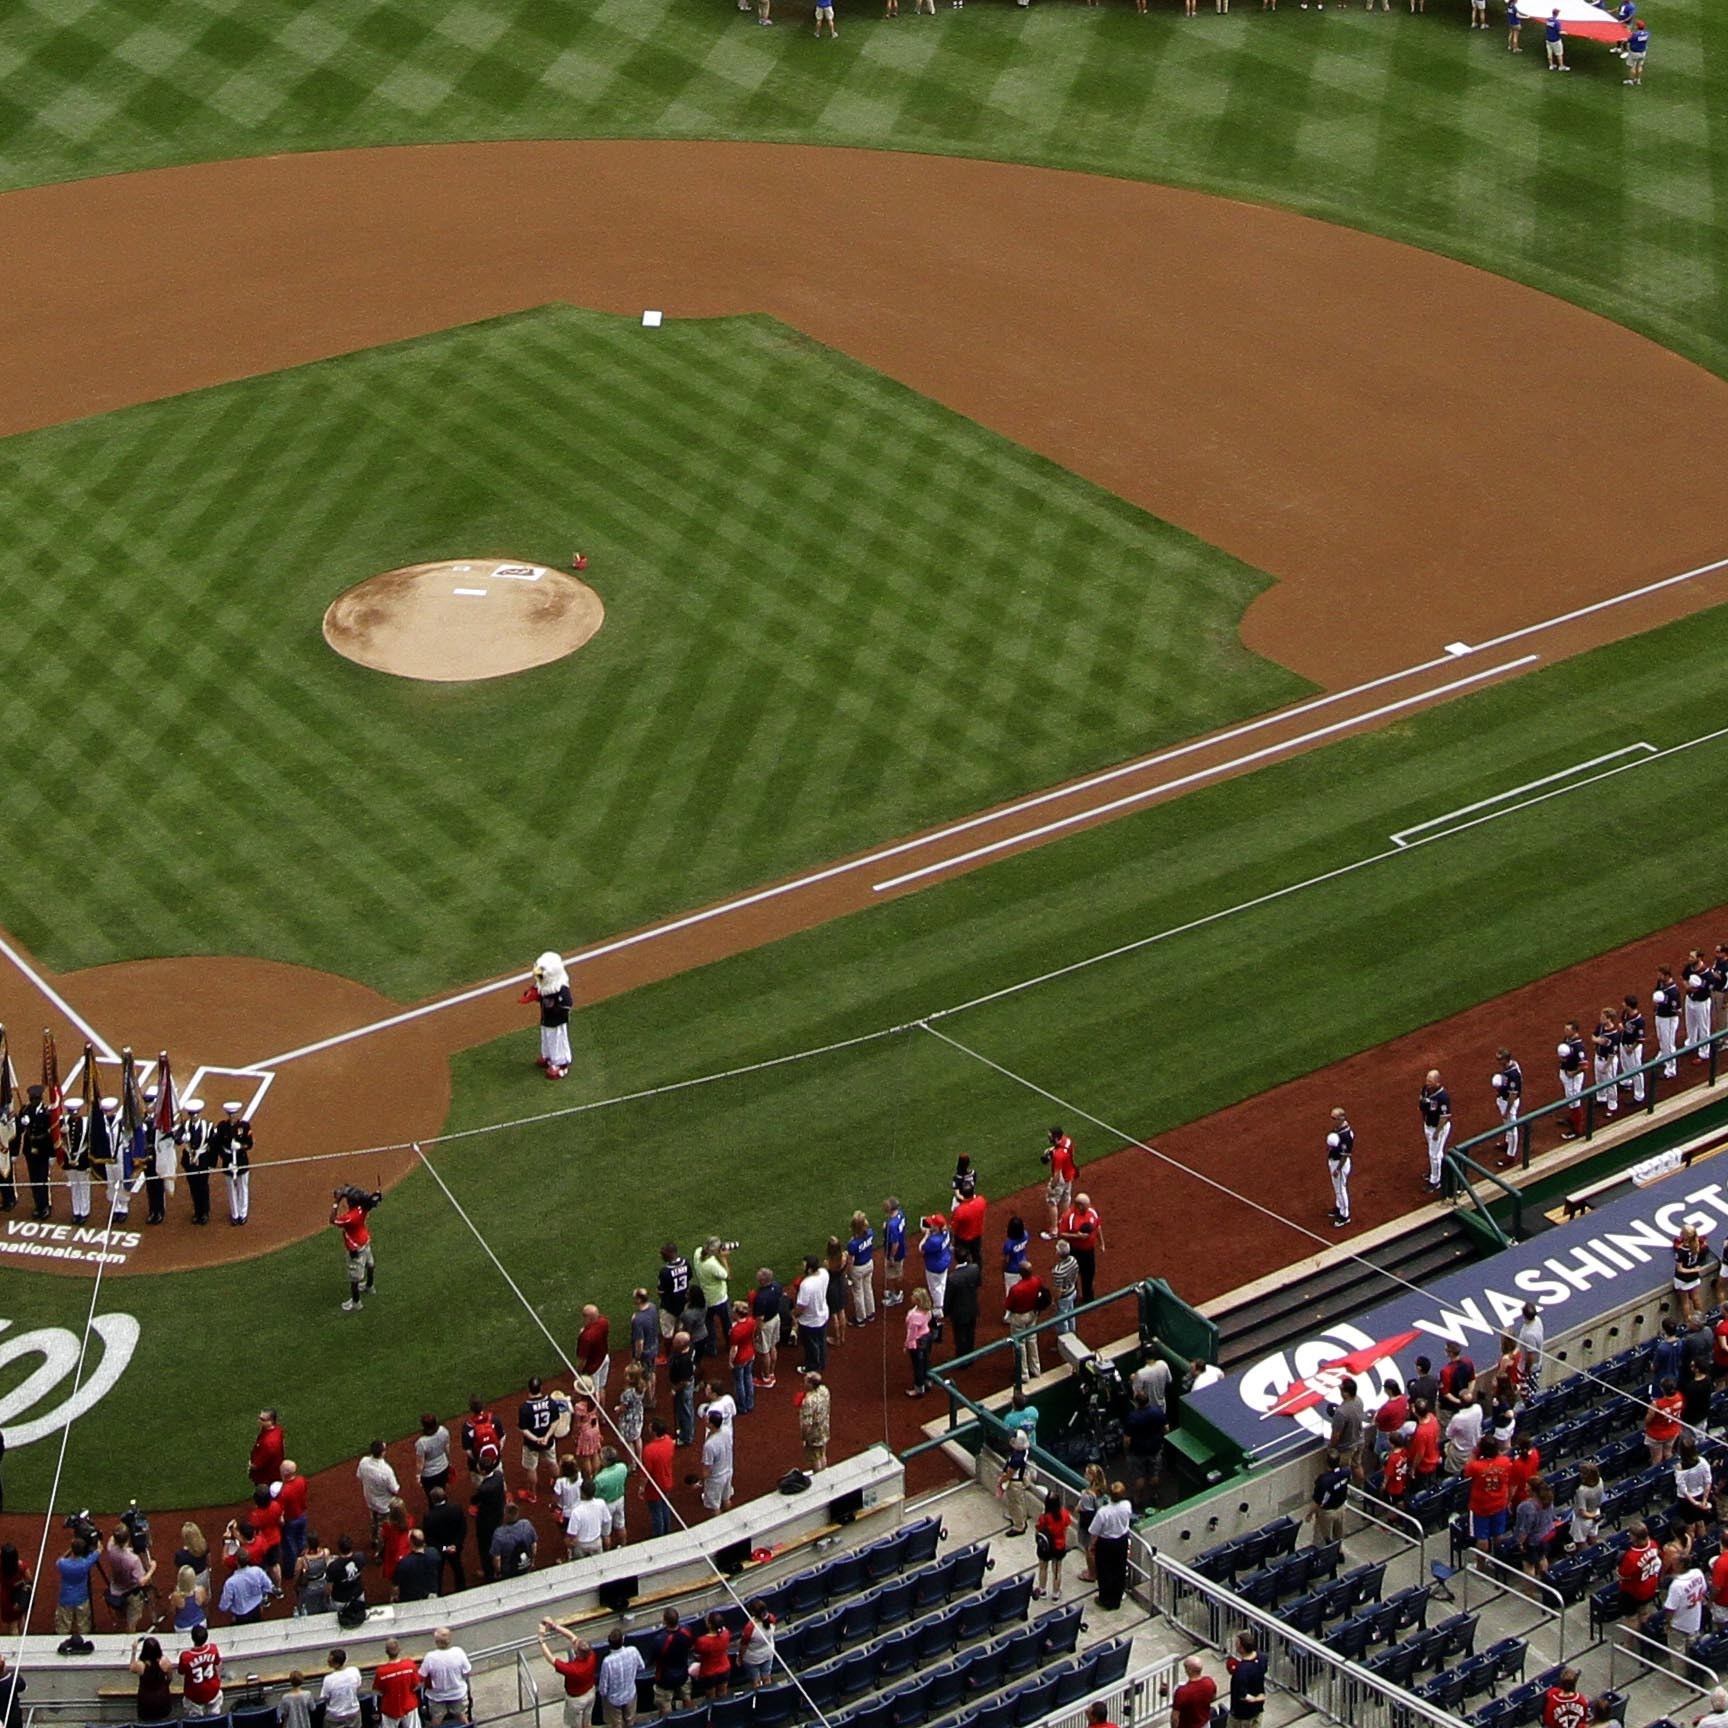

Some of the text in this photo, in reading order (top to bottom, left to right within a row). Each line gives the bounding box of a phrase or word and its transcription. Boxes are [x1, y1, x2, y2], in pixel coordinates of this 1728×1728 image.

[6, 1220, 142, 1248] VOTE NATS
[673, 1275, 688, 1294] 13
[533, 1411, 550, 1429] 13
